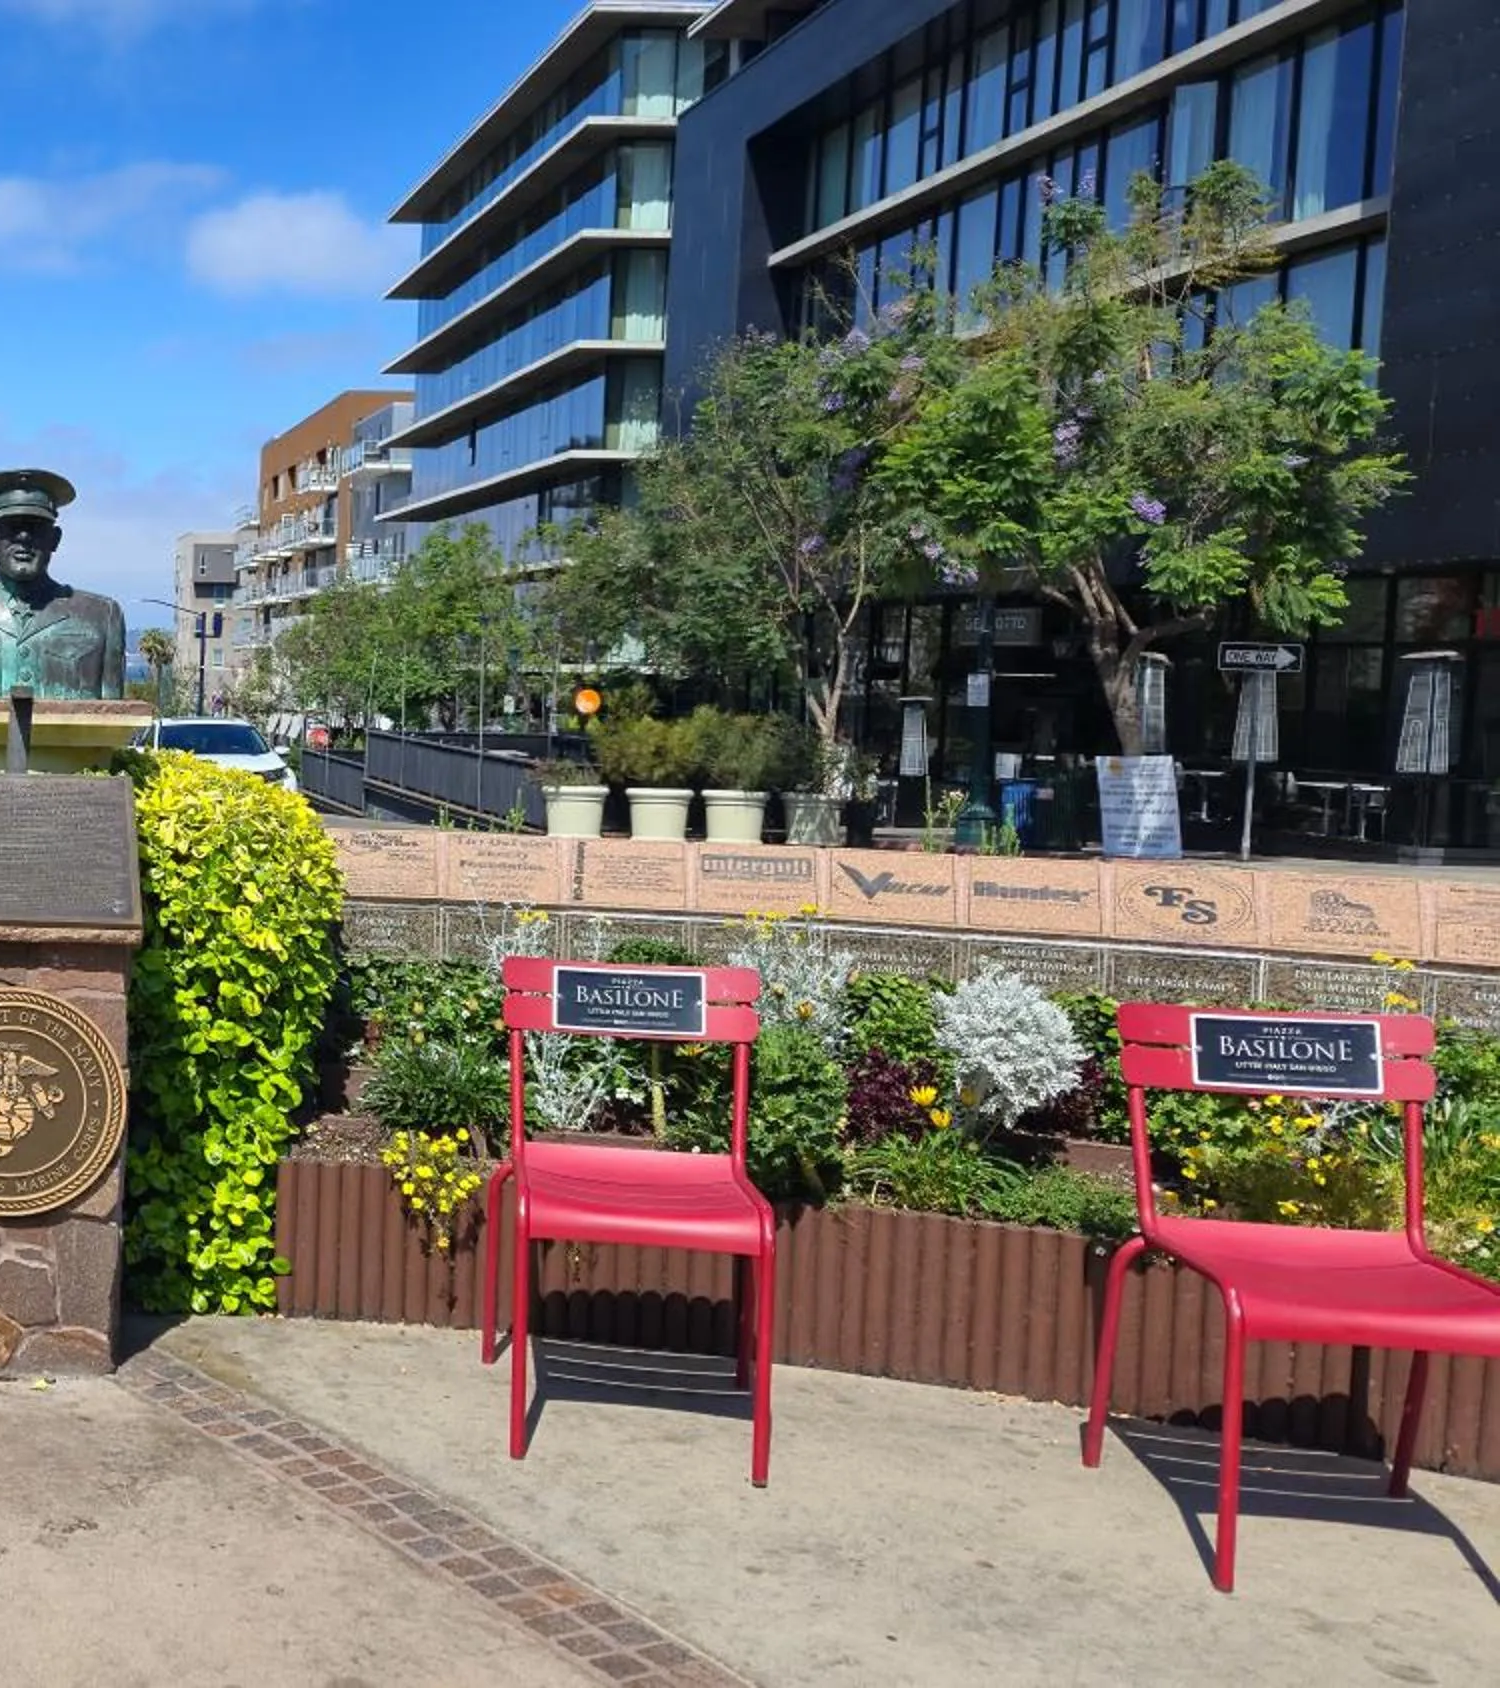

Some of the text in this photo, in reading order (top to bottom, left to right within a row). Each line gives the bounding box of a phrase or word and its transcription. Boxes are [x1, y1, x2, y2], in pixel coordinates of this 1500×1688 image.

[1228, 651, 1277, 663] ONE WAY
[611, 977, 645, 986] PIAZZA
[576, 985, 685, 1009] BASILONE
[587, 1007, 670, 1019] LITTLE ITALY SAN DIEGO
[1262, 1026, 1303, 1036] PIAZZA
[19, 1010, 38, 1024] OF
[44, 1018, 69, 1041] THE
[70, 1042, 103, 1089] NAVY
[1219, 1035, 1354, 1062] BASILONE
[1235, 1060, 1337, 1073] LITTLE ITALY SAN DIEGO
[15, 1162, 72, 1194] MARINE
[72, 1117, 102, 1161] CORPS
